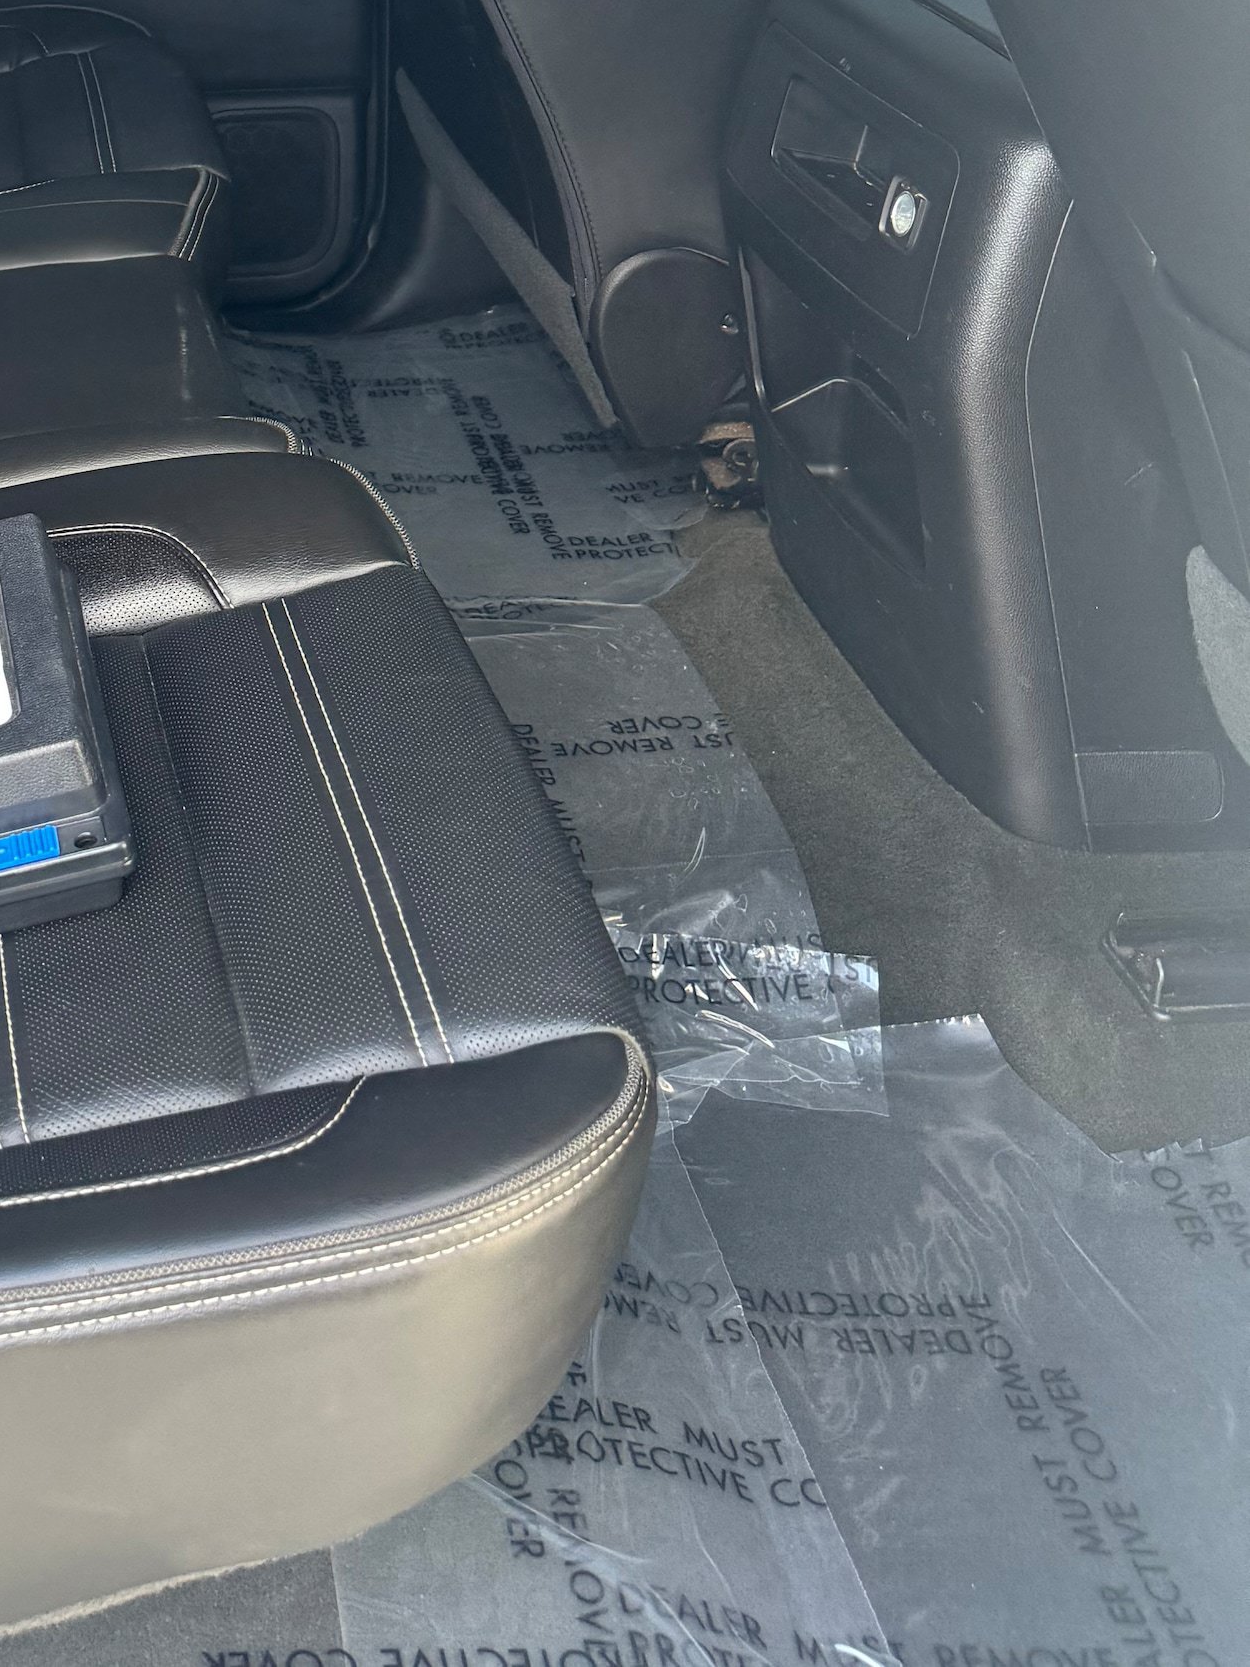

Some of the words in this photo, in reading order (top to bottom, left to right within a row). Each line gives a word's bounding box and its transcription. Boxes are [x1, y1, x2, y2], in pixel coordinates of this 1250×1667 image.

[497, 499, 531, 535] COVER
[569, 532, 653, 547] DEALER
[607, 715, 703, 735] COVER
[551, 735, 675, 757] REMOVE
[740, 1285, 959, 1318] PROTECTIVE
[705, 1318, 805, 1352] MUST
[836, 1327, 973, 1356] DEALER
[538, 1395, 659, 1434] EALER
[682, 1421, 784, 1468] MUST
[958, 1292, 1051, 1432] REMOVE
[1031, 1452, 1113, 1559] MUST
[1039, 1366, 1119, 1483] COVER
